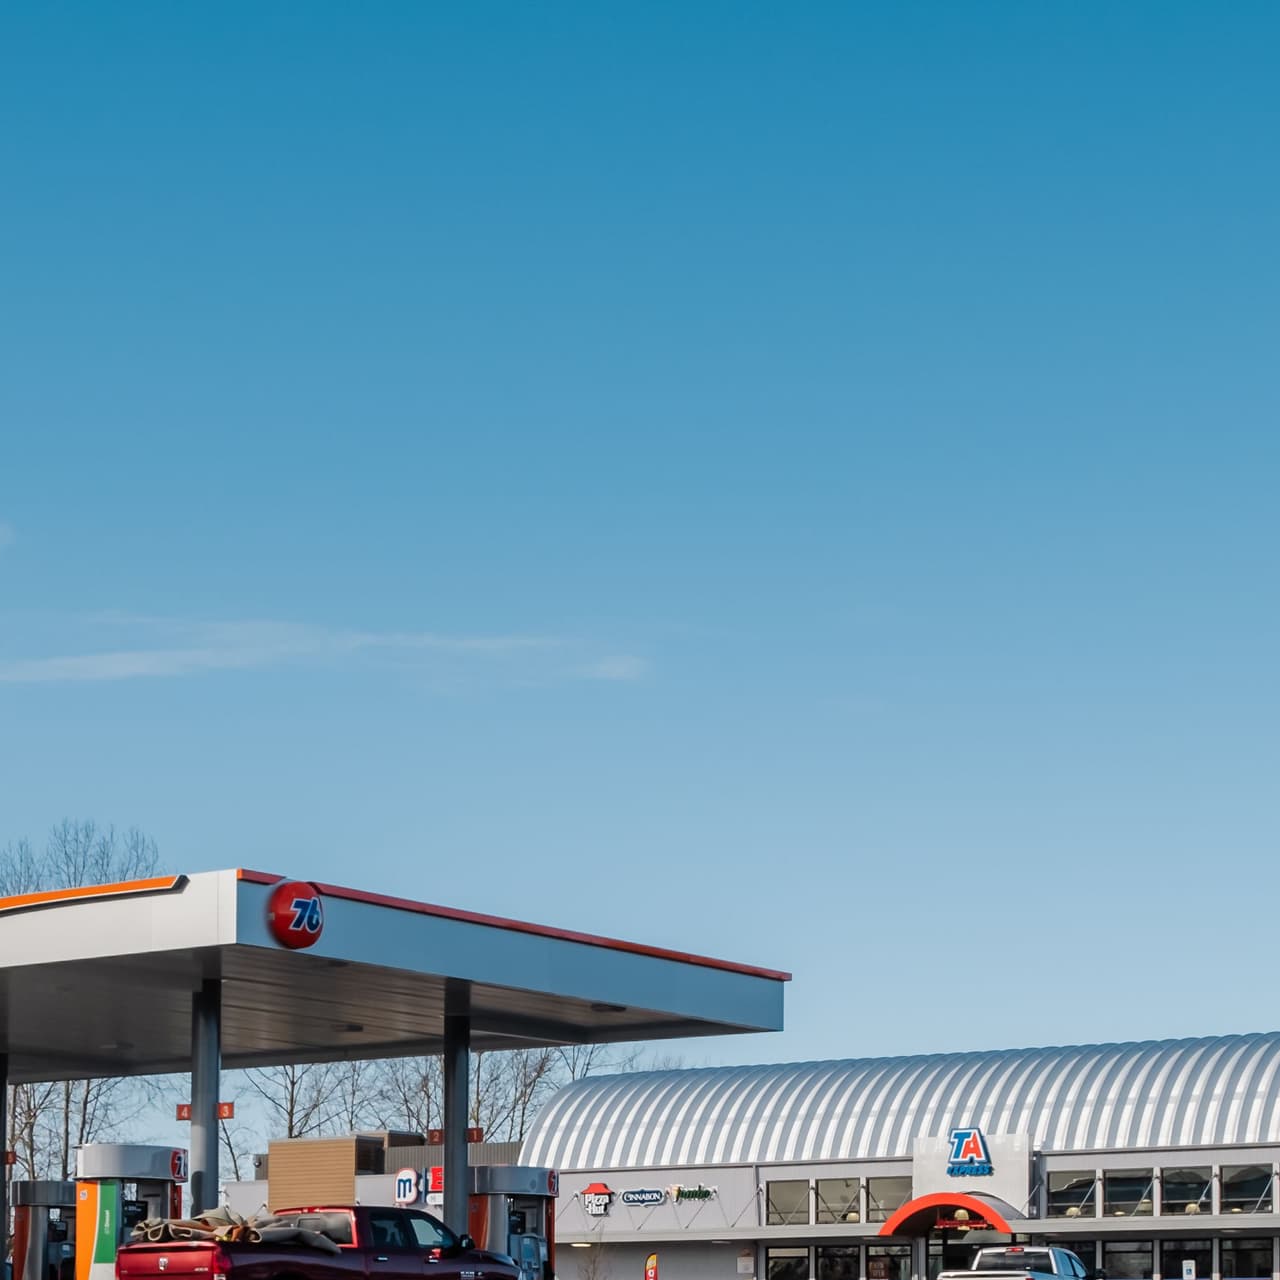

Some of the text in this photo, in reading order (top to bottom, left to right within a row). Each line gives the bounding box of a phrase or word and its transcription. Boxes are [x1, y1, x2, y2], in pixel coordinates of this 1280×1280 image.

[288, 896, 322, 934] 76
[949, 1128, 990, 1163] TA
[585, 1193, 609, 1205] Pizza
[624, 1192, 661, 1202] CINNABON
[585, 1203, 605, 1214] Hut
